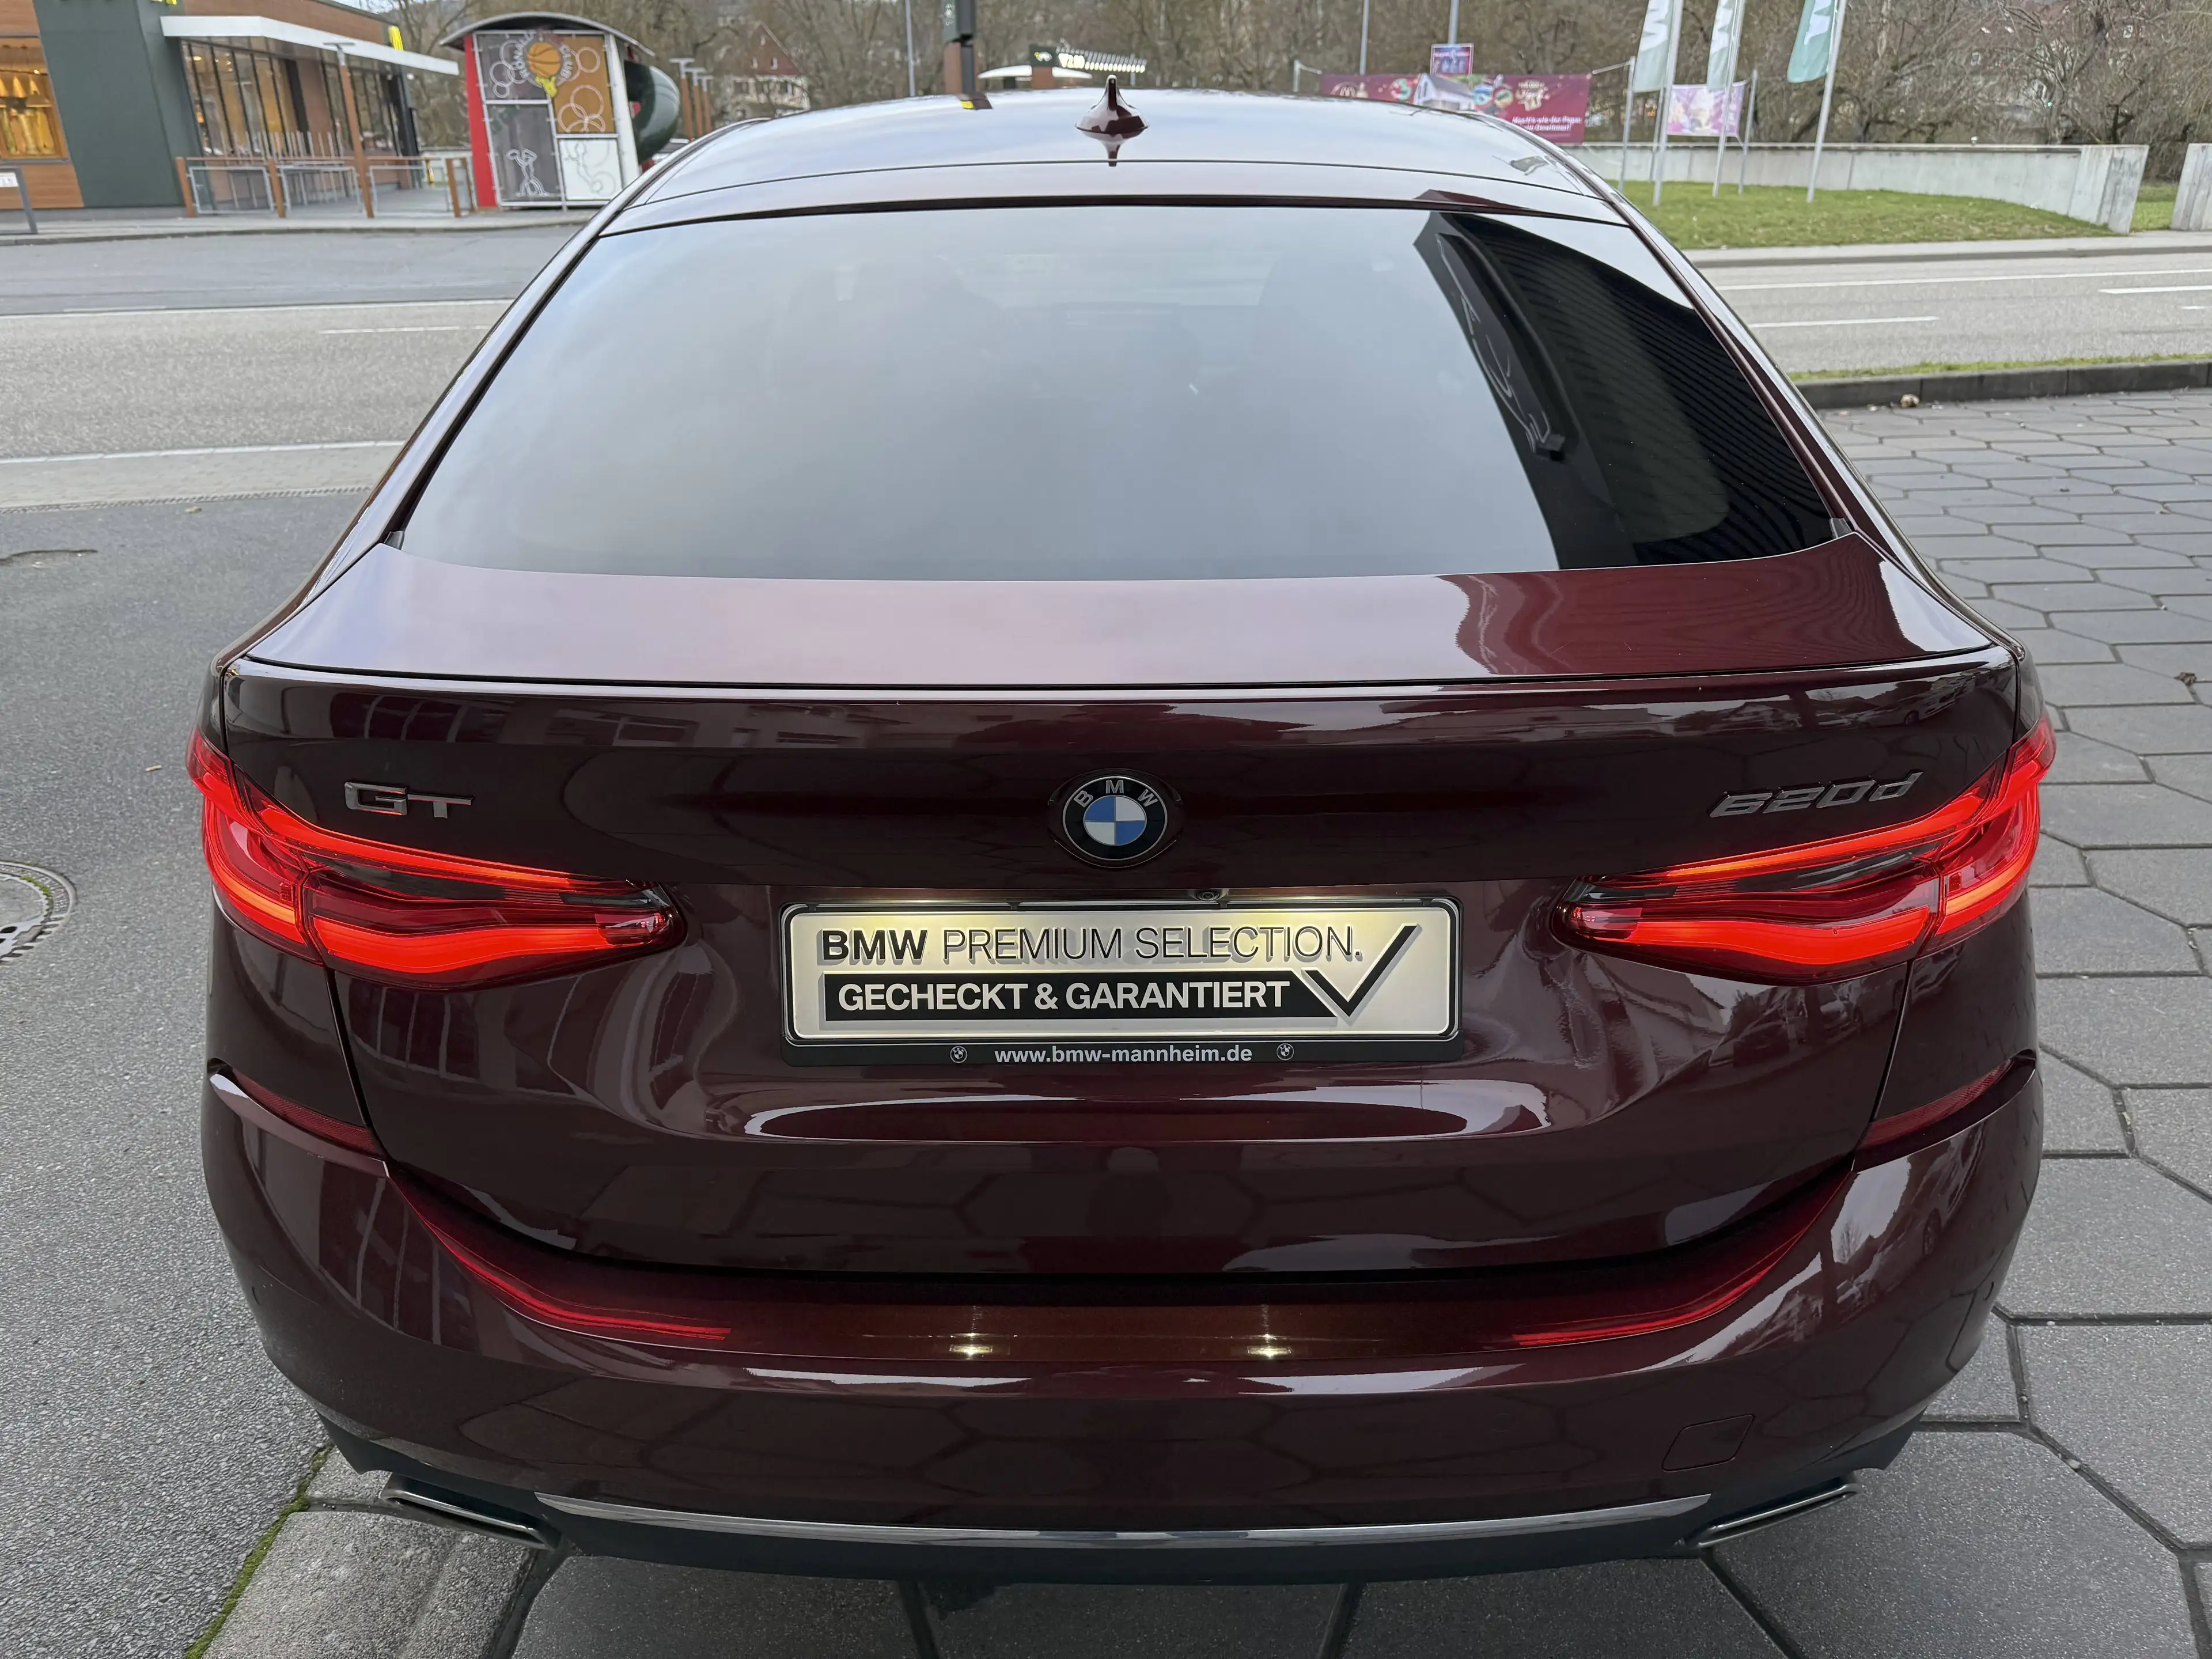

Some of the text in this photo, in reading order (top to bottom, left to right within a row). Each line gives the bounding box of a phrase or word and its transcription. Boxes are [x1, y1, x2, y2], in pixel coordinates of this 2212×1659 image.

[344, 781, 474, 819] GT
[1073, 779, 1159, 808] BMW
[1709, 770, 1924, 818] 620d
[823, 925, 1362, 961] BMW PREMIUM SELECTION.
[838, 980, 1290, 1012] GECHECKT & GARANTIERT
[994, 1044, 1253, 1063] www.bmw-mannheim.de
